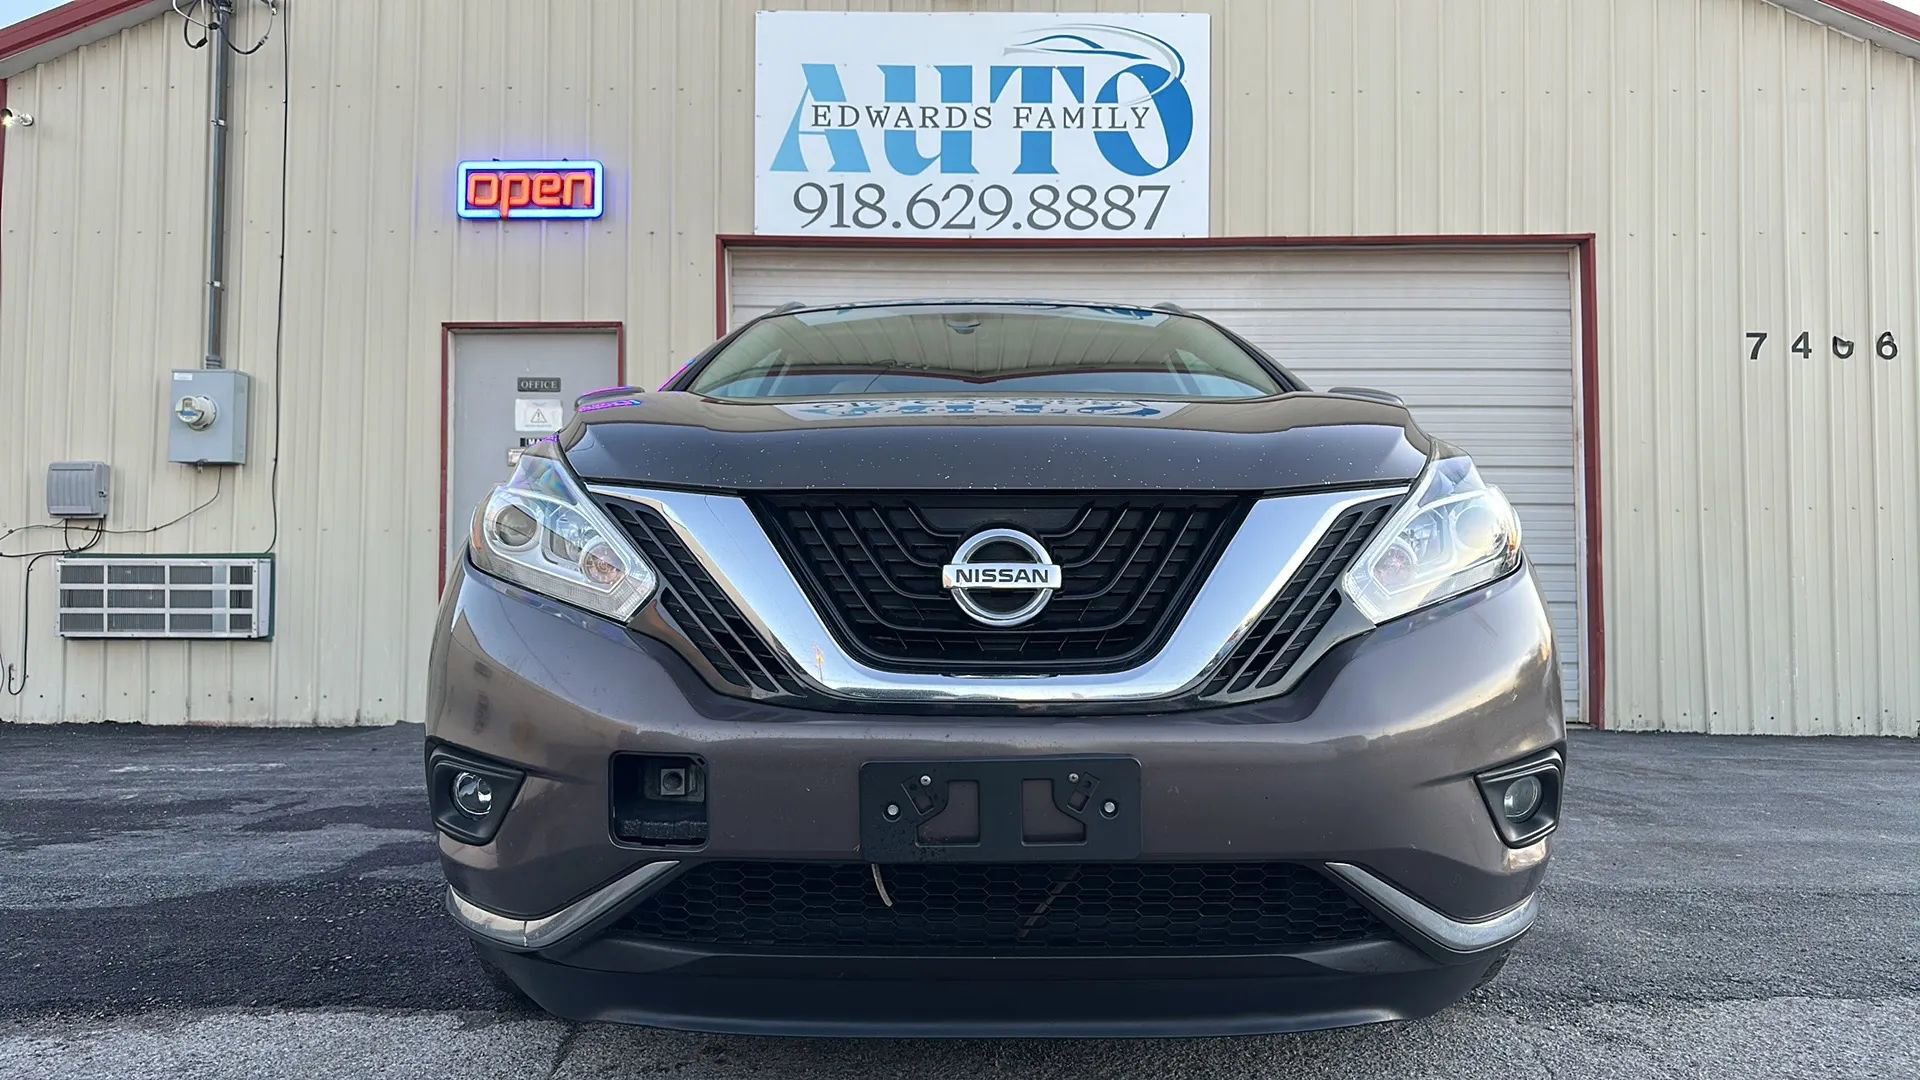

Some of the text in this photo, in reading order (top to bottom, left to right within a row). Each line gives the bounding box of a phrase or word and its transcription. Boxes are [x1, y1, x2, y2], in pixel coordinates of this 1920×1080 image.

[770, 63, 1193, 176] AUTO
[811, 104, 1151, 129] EDWARDS FAMILY
[467, 172, 593, 220] open
[793, 182, 1171, 231] 918.629.8887
[520, 380, 558, 389] OFFICE
[955, 568, 1049, 583] NISSAN
